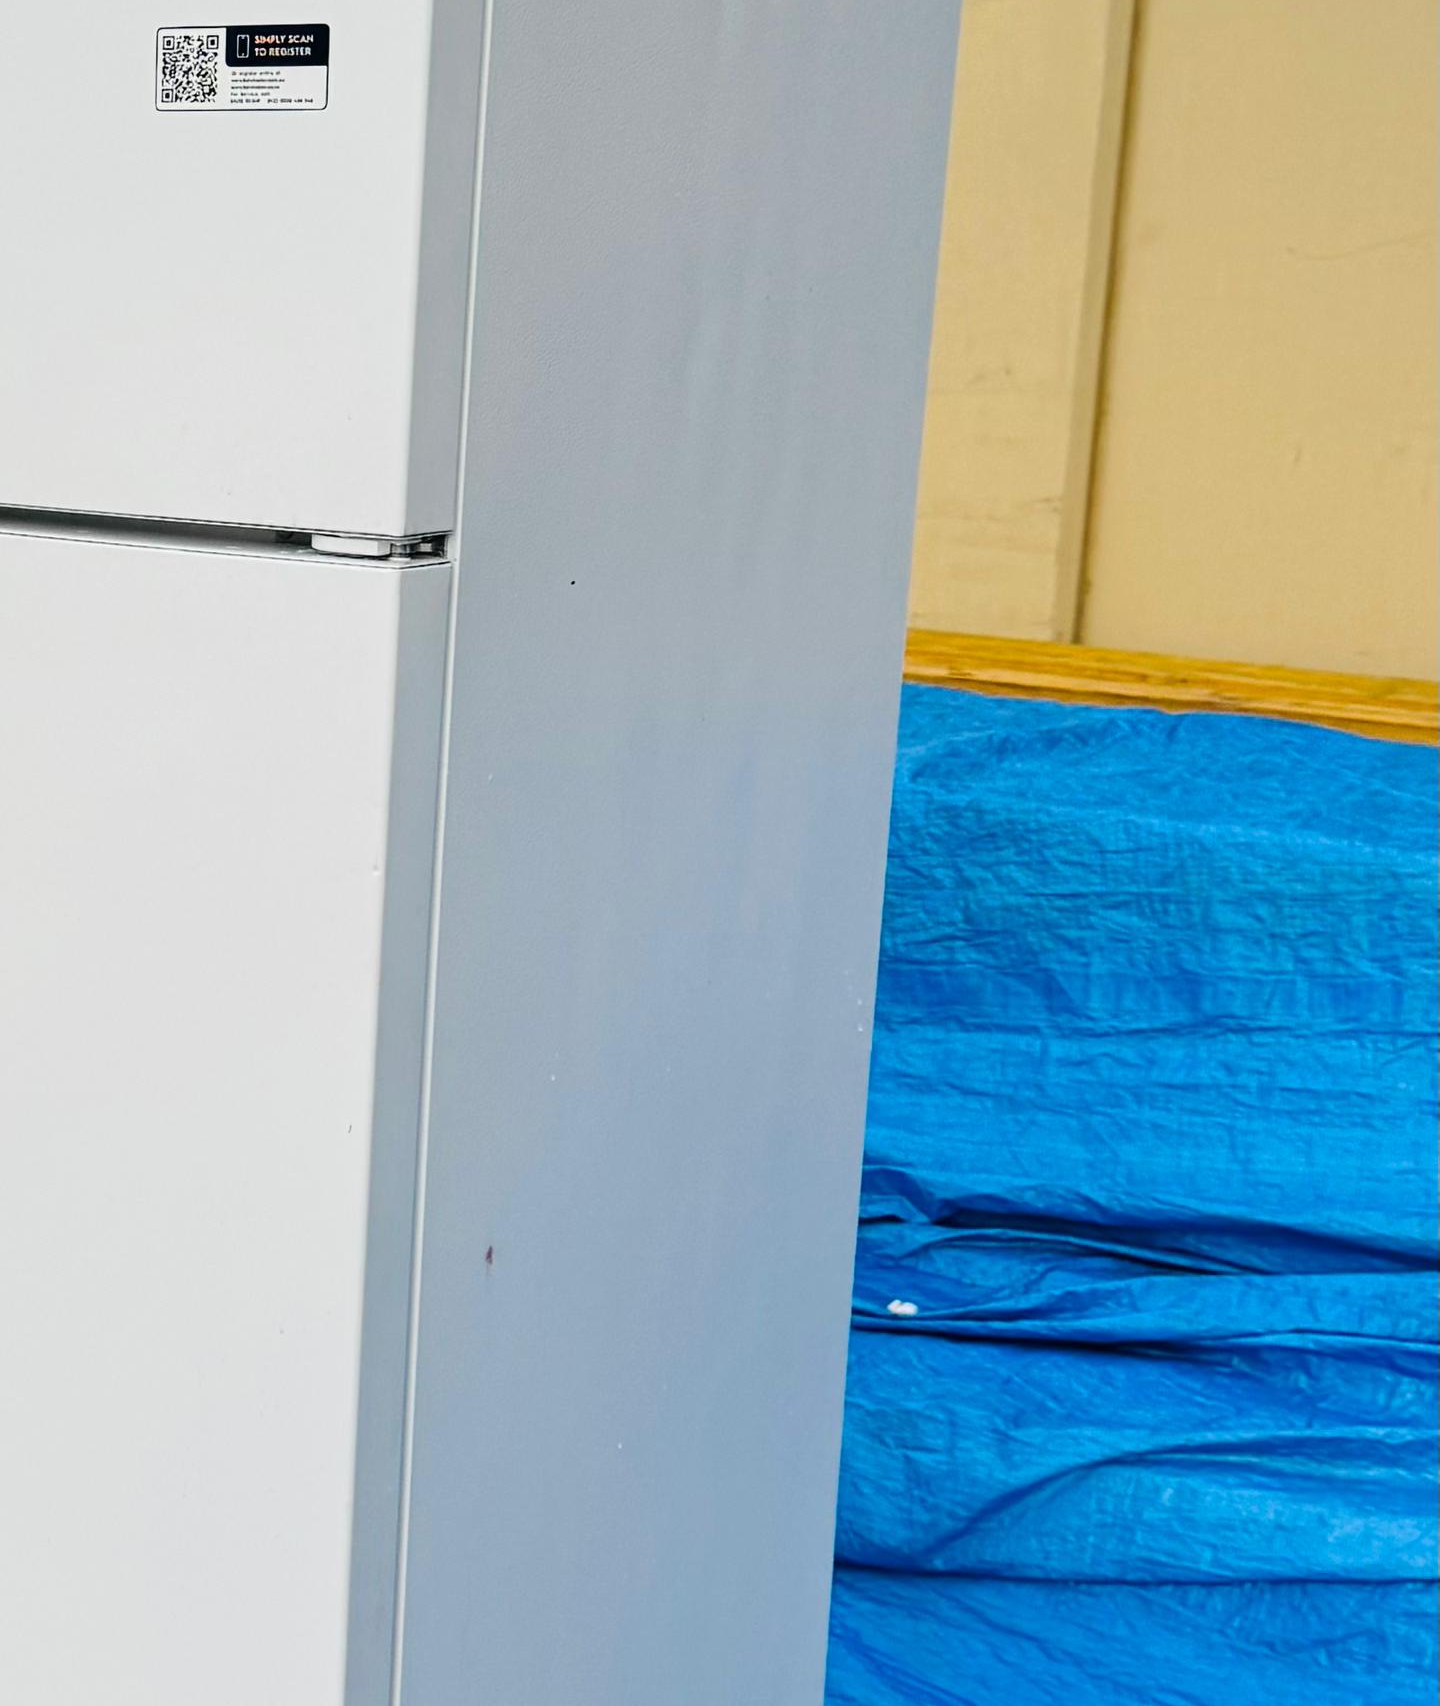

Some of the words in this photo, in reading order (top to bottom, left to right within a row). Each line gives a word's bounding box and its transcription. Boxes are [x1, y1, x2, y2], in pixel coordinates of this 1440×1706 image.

[254, 35, 286, 44] SIMPLY
[288, 34, 314, 43] SCAN
[254, 47, 267, 56] TO
[269, 47, 311, 56] REGISTER
